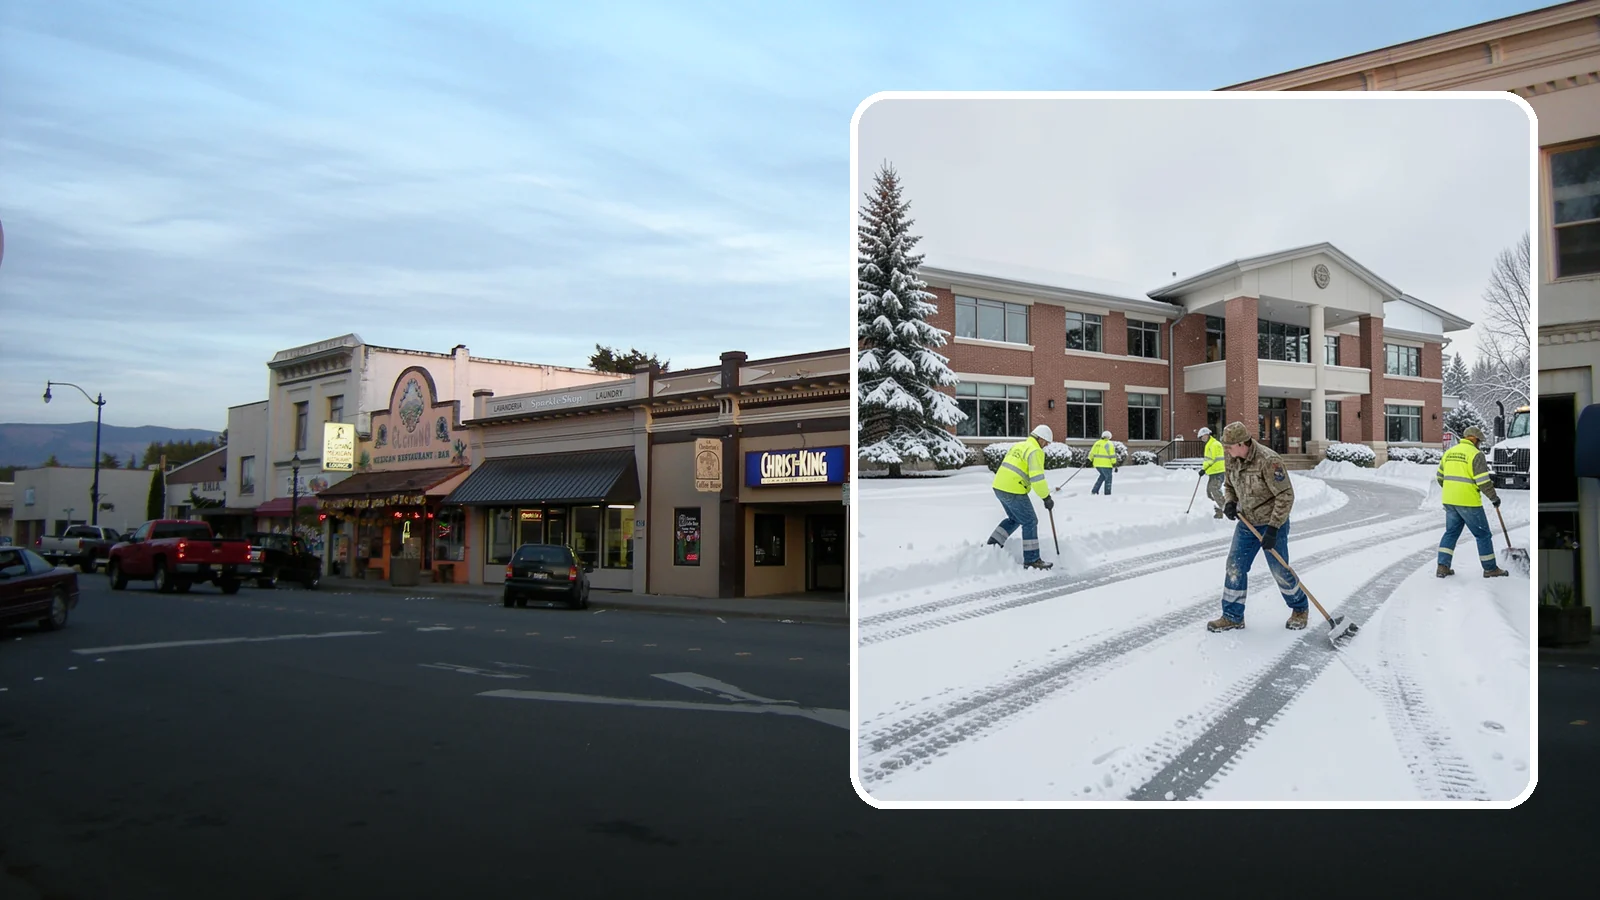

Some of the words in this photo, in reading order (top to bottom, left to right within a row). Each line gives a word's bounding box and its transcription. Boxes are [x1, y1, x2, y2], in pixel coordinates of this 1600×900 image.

[531, 396, 561, 409] Sparkle
[562, 394, 582, 404] Shop
[595, 389, 624, 400] LAUNDRY
[494, 402, 522, 412] LAVANDERIA
[373, 454, 396, 464] MEXICAN
[397, 451, 433, 462] RESTAURANT
[438, 450, 450, 458] BAR
[761, 452, 797, 478] CHRIST
[799, 450, 827, 476] KING
